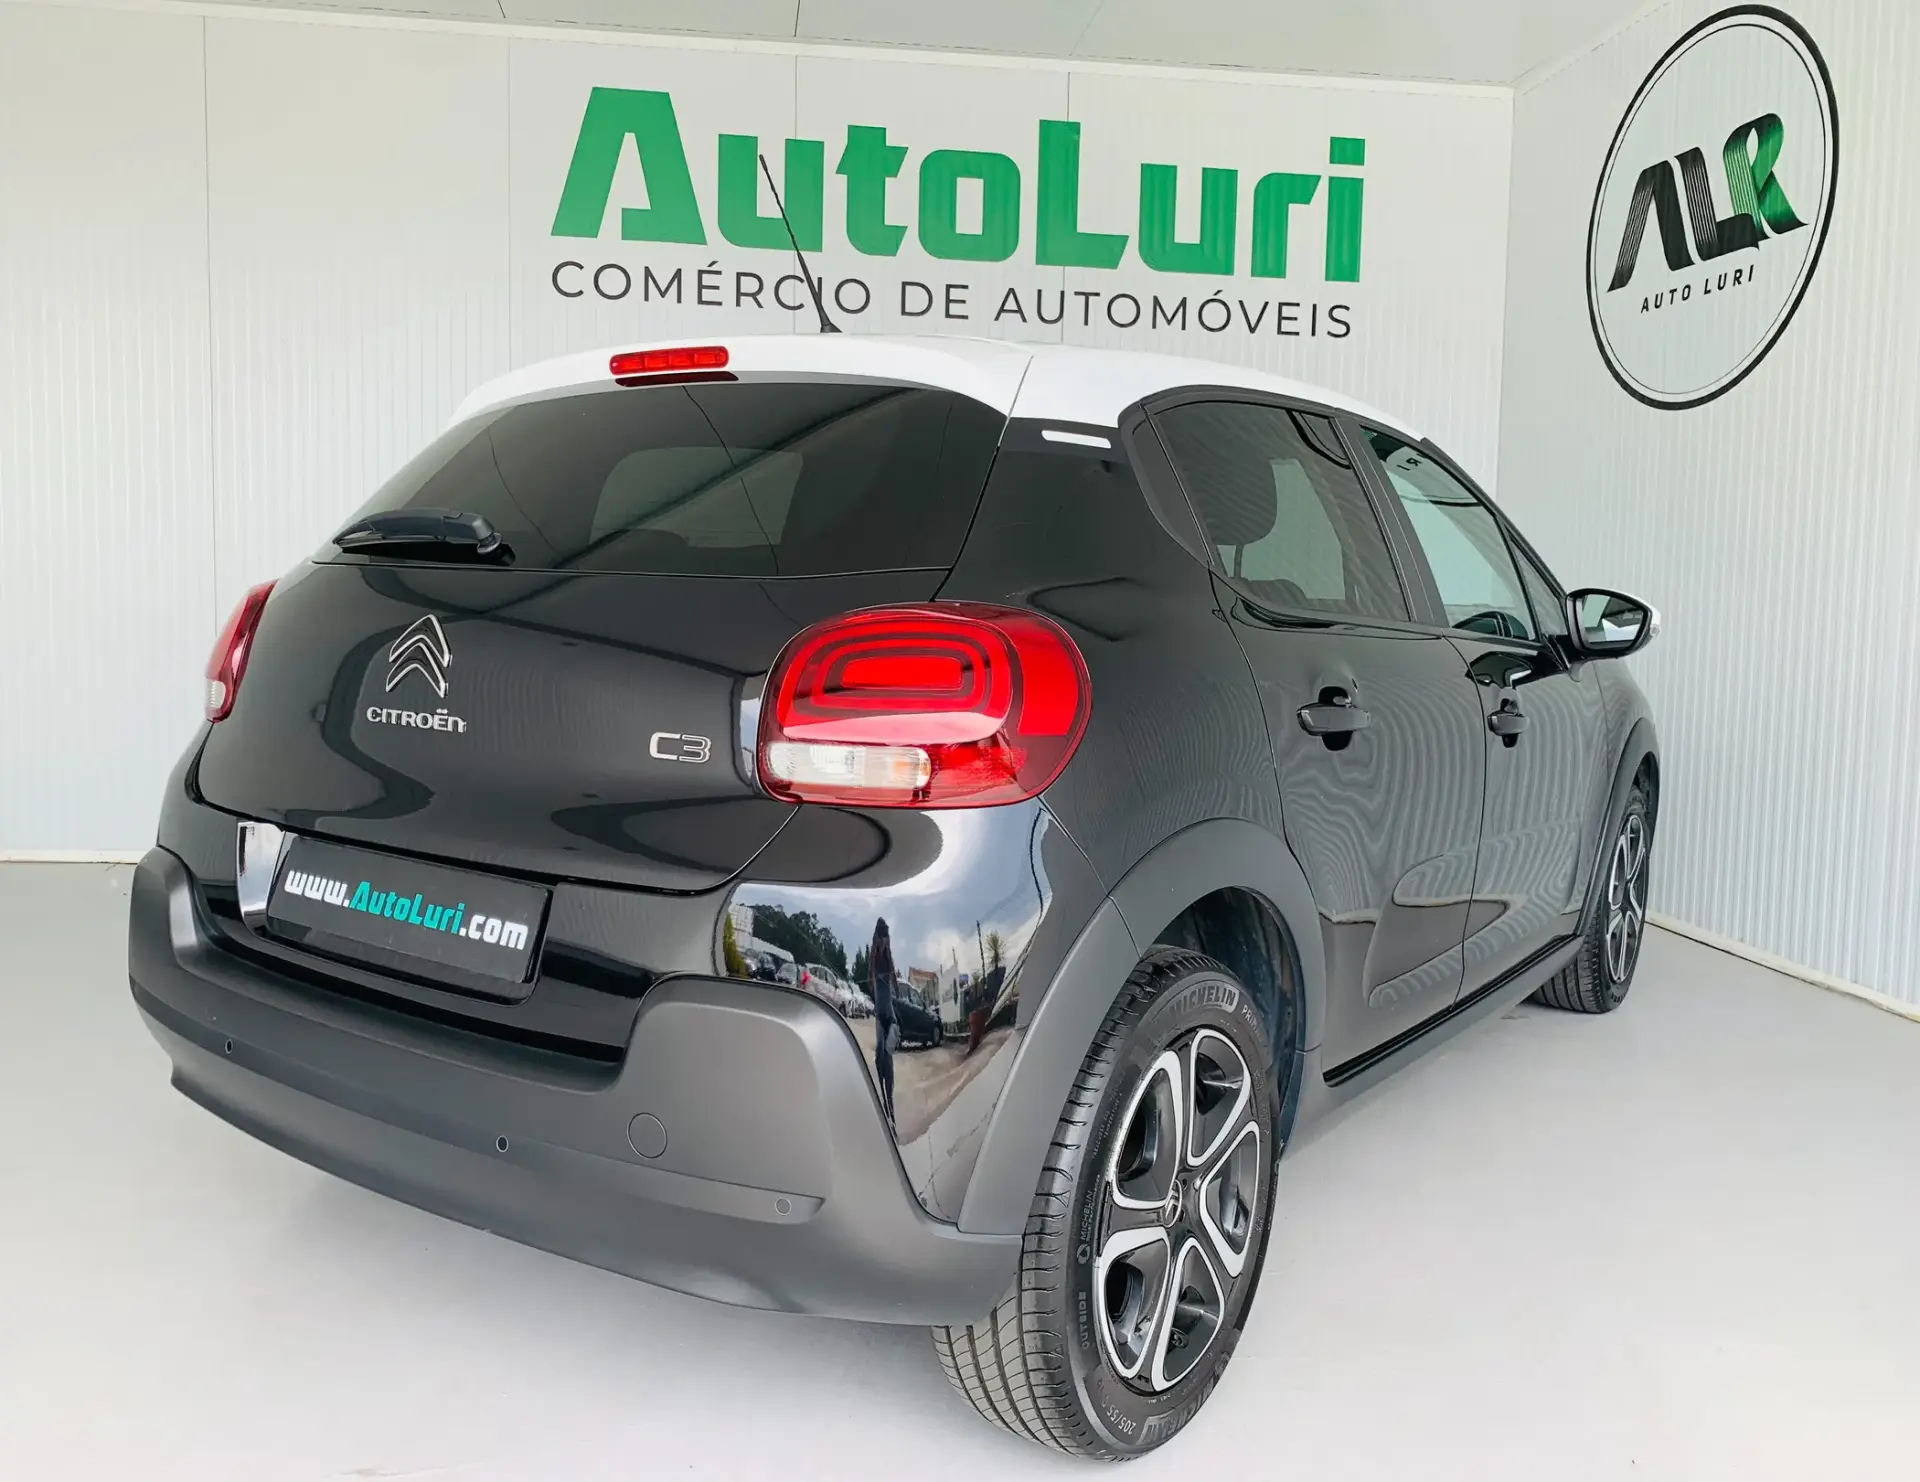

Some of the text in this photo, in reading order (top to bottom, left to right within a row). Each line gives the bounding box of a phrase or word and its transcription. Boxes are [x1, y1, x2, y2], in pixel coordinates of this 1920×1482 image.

[551, 86, 1365, 283] AutoLuri
[551, 260, 1352, 338] COMÉRCIO DE AUTOMÓVEIS
[1640, 264, 1755, 314] AUTO LURI
[648, 731, 712, 763] C3
[284, 869, 528, 950] www.AutoLuri.com
[1081, 1190, 1092, 1241] MICHELIN
[1079, 1291, 1090, 1350] OUTSIDE
[1105, 1404, 1137, 1436] 205/55
